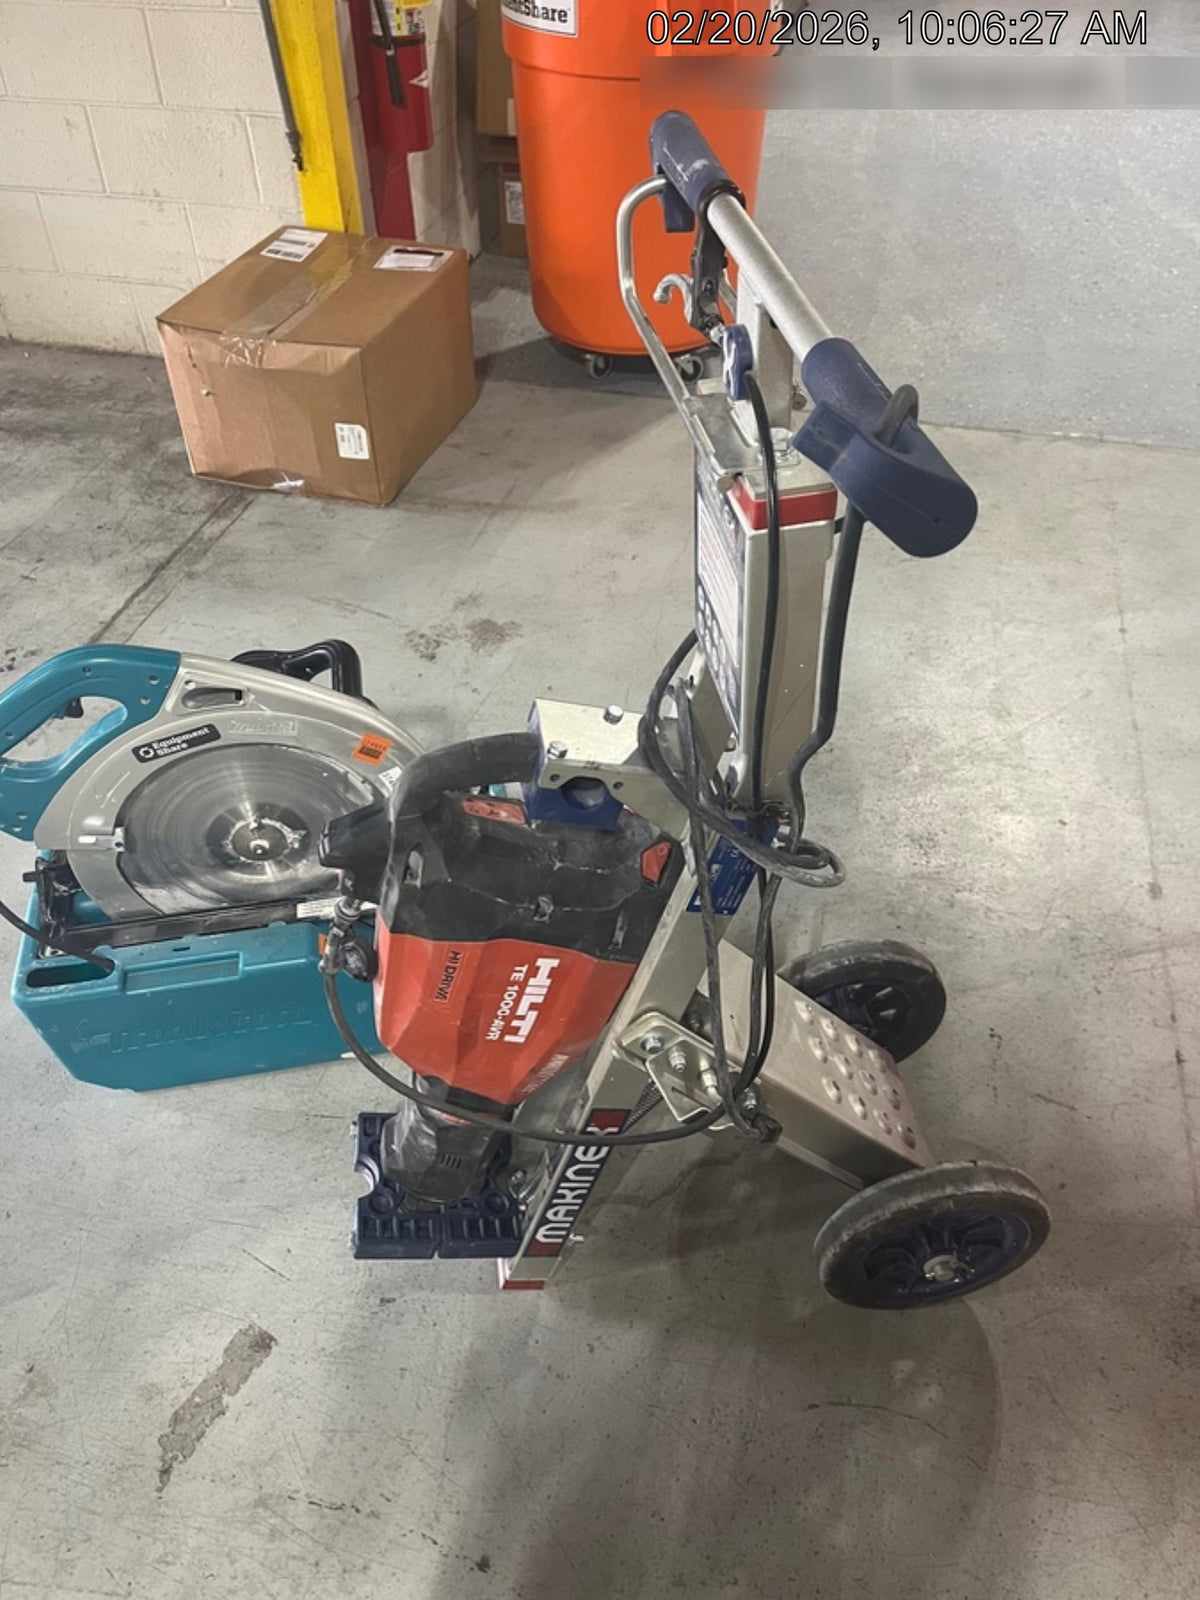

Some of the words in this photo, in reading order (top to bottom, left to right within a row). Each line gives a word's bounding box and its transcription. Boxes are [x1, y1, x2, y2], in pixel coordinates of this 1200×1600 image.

[152, 727, 210, 749] Equipment
[510, 964, 528, 982] TE
[485, 984, 519, 1041] 1000-AVR
[503, 957, 560, 1043] HILTI
